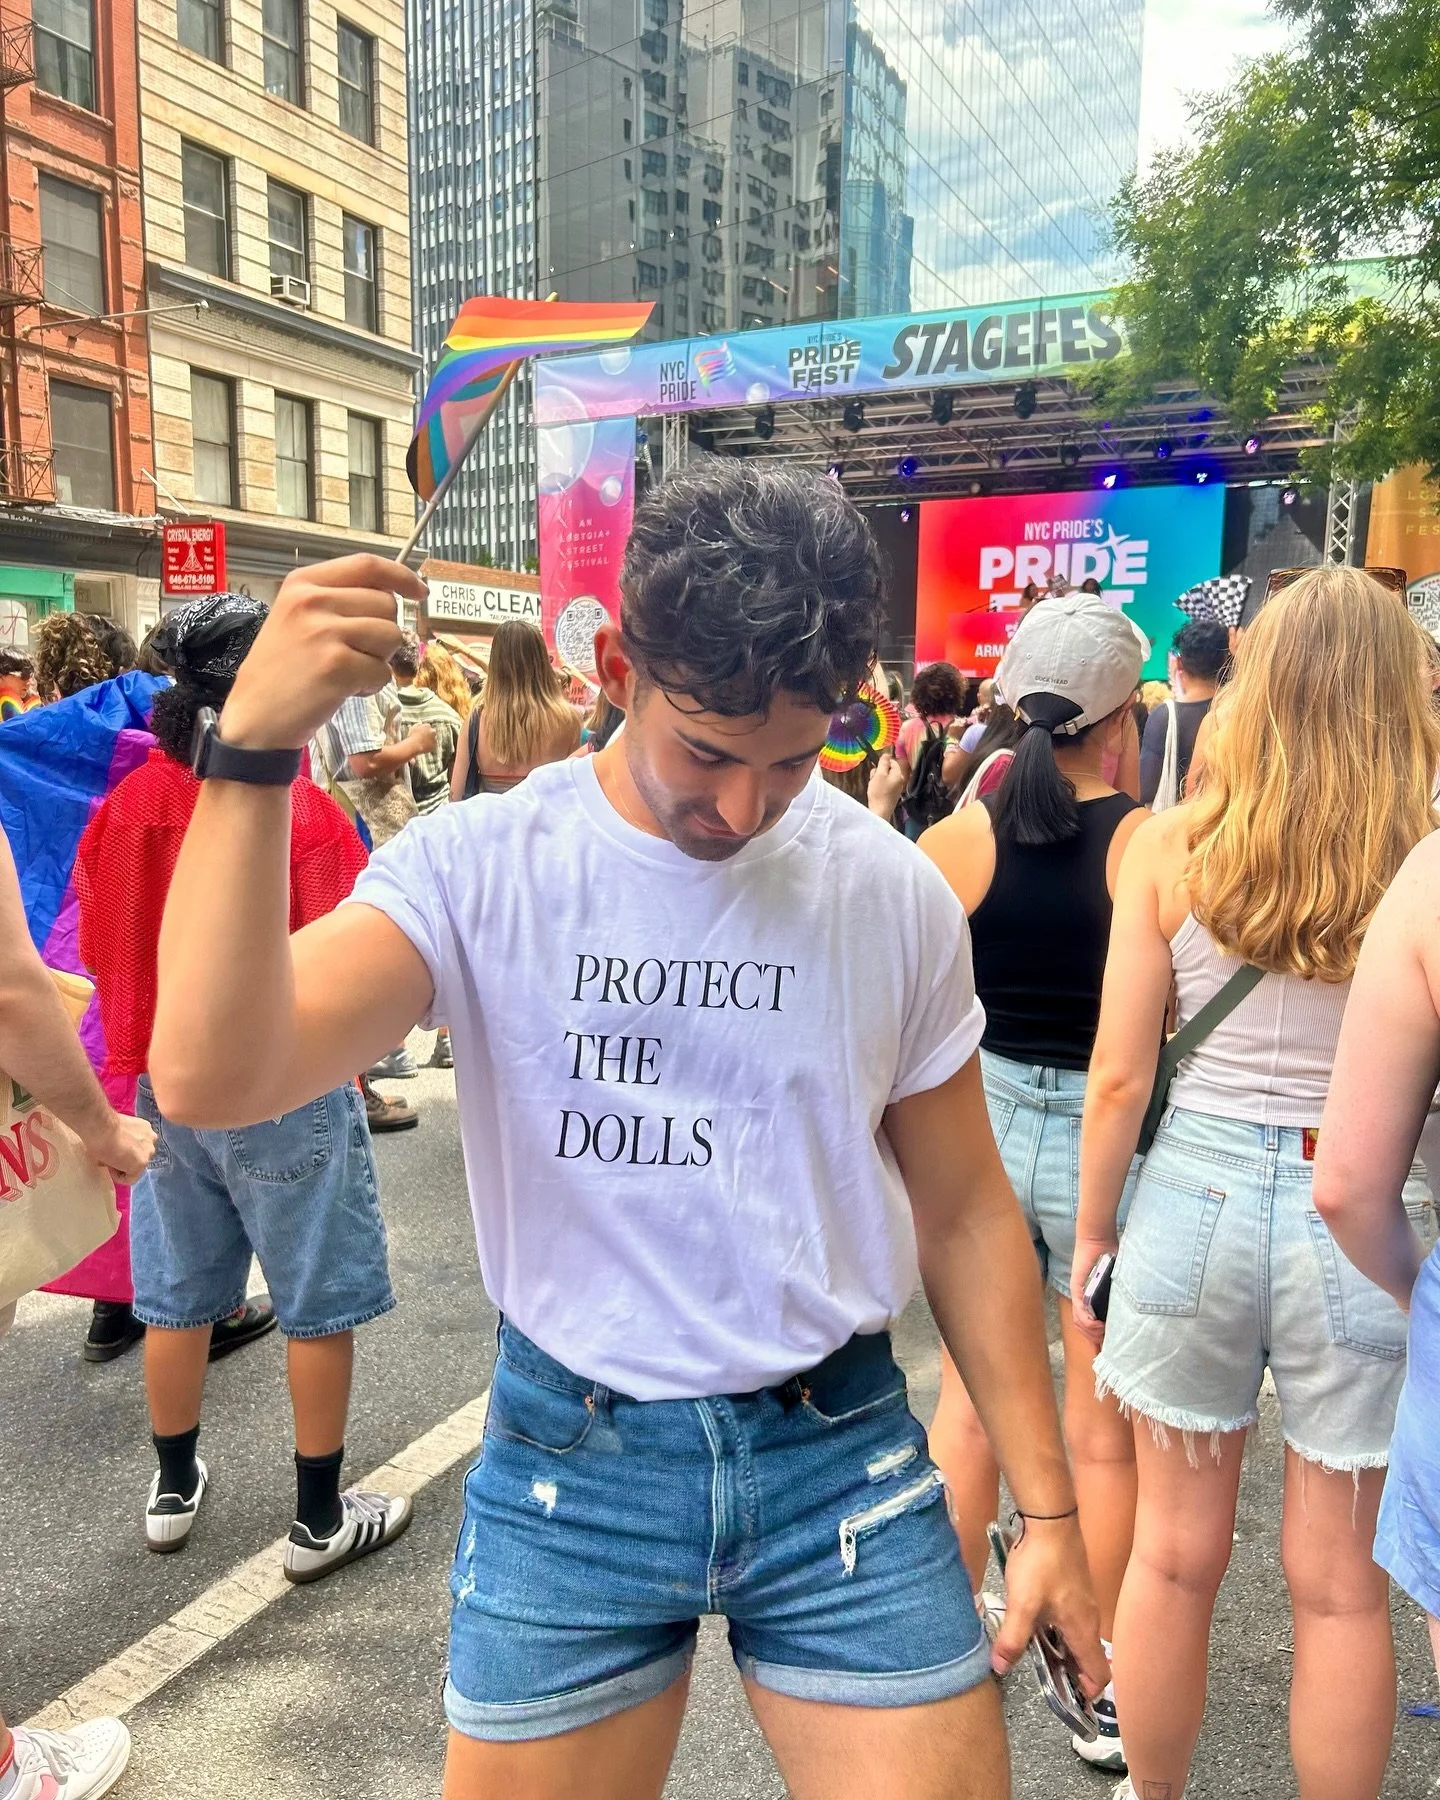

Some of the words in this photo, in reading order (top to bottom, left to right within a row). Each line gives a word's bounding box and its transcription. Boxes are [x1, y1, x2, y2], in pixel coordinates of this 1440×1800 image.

[788, 340, 862, 367] PRIDE
[659, 360, 685, 382] NYC
[792, 363, 855, 389] FEST
[659, 380, 697, 403] PRIDE
[167, 528, 191, 542] CRYSTAL
[192, 528, 214, 541] ENERGY
[1024, 521, 1050, 541] NYC
[1053, 518, 1103, 540] PRIDE'S
[566, 544, 604, 555] STREET
[979, 539, 1149, 590] PRIDE
[442, 585, 476, 601] CHRIS
[436, 600, 481, 618] FRENCH
[975, 644, 1008, 658] ARM
[570, 953, 796, 1012] PROTECT
[563, 1031, 662, 1085] THE
[555, 1109, 713, 1167] DOLLS
